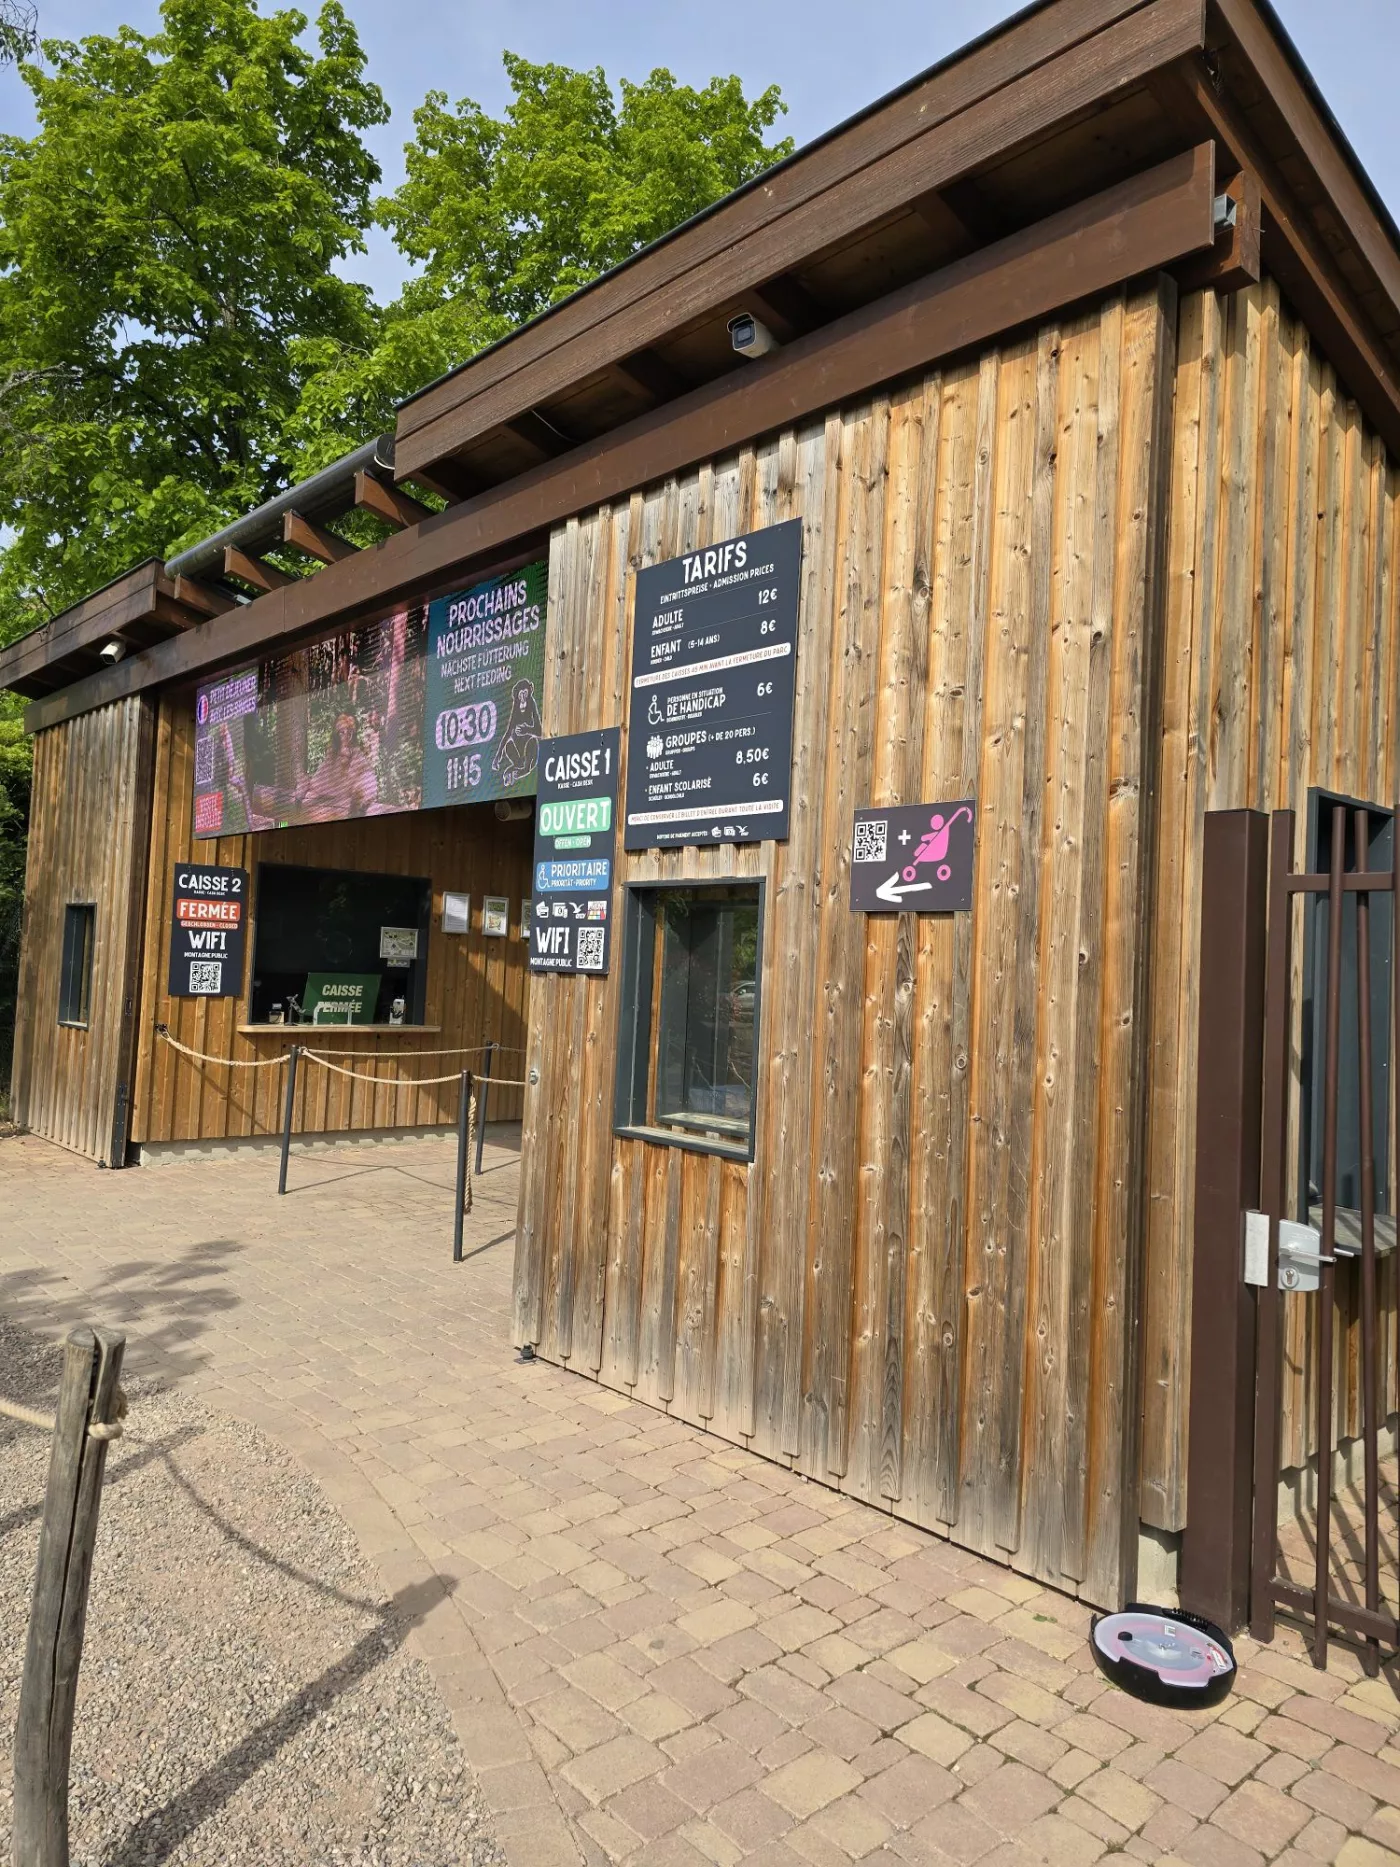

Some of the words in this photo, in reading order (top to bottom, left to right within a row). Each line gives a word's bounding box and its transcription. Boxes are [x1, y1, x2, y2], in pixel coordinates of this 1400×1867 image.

[682, 541, 747, 584] TARIFS
[660, 582, 708, 604] EINTRITTSPREISE
[713, 569, 749, 589] ADMISSION
[750, 563, 774, 579] PRICES
[449, 580, 527, 628] PROCHAINS
[758, 588, 778, 605] 12€
[652, 609, 683, 629] ADULTE
[760, 619, 776, 635] 8€
[436, 604, 540, 659] NOURRISSAGES
[650, 639, 682, 658] ENFANT
[687, 637, 704, 649] (5-14
[705, 634, 721, 645] ANS)
[733, 652, 763, 665] FERMETURE
[454, 675, 476, 694] NEXT
[477, 665, 512, 688] FEEDING
[756, 682, 773, 697] 6€
[666, 703, 679, 717] DE
[679, 693, 726, 714] HANDICAP
[441, 704, 492, 747] 10:30
[665, 730, 707, 748] GROUPES
[715, 731, 724, 741] DE
[724, 730, 734, 740] 20
[734, 726, 756, 738] PERS.)
[545, 750, 601, 782] CAISSE
[604, 748, 611, 775] 1
[649, 759, 674, 772] ADULTE
[735, 748, 770, 765] 8,50€
[446, 753, 482, 790] 11:15
[752, 772, 769, 787] 6€
[648, 782, 673, 795] ENFANT
[674, 776, 712, 792] SCOLARISÉ
[540, 801, 611, 832] OUVERT
[551, 861, 608, 877] PRIORITAIRE
[178, 873, 229, 892] CAISSE
[231, 878, 242, 893] 2
[180, 901, 237, 920] FERMÉE
[188, 930, 227, 950] WIFI
[536, 927, 570, 954] WIFI
[322, 984, 363, 997] CAISSE
